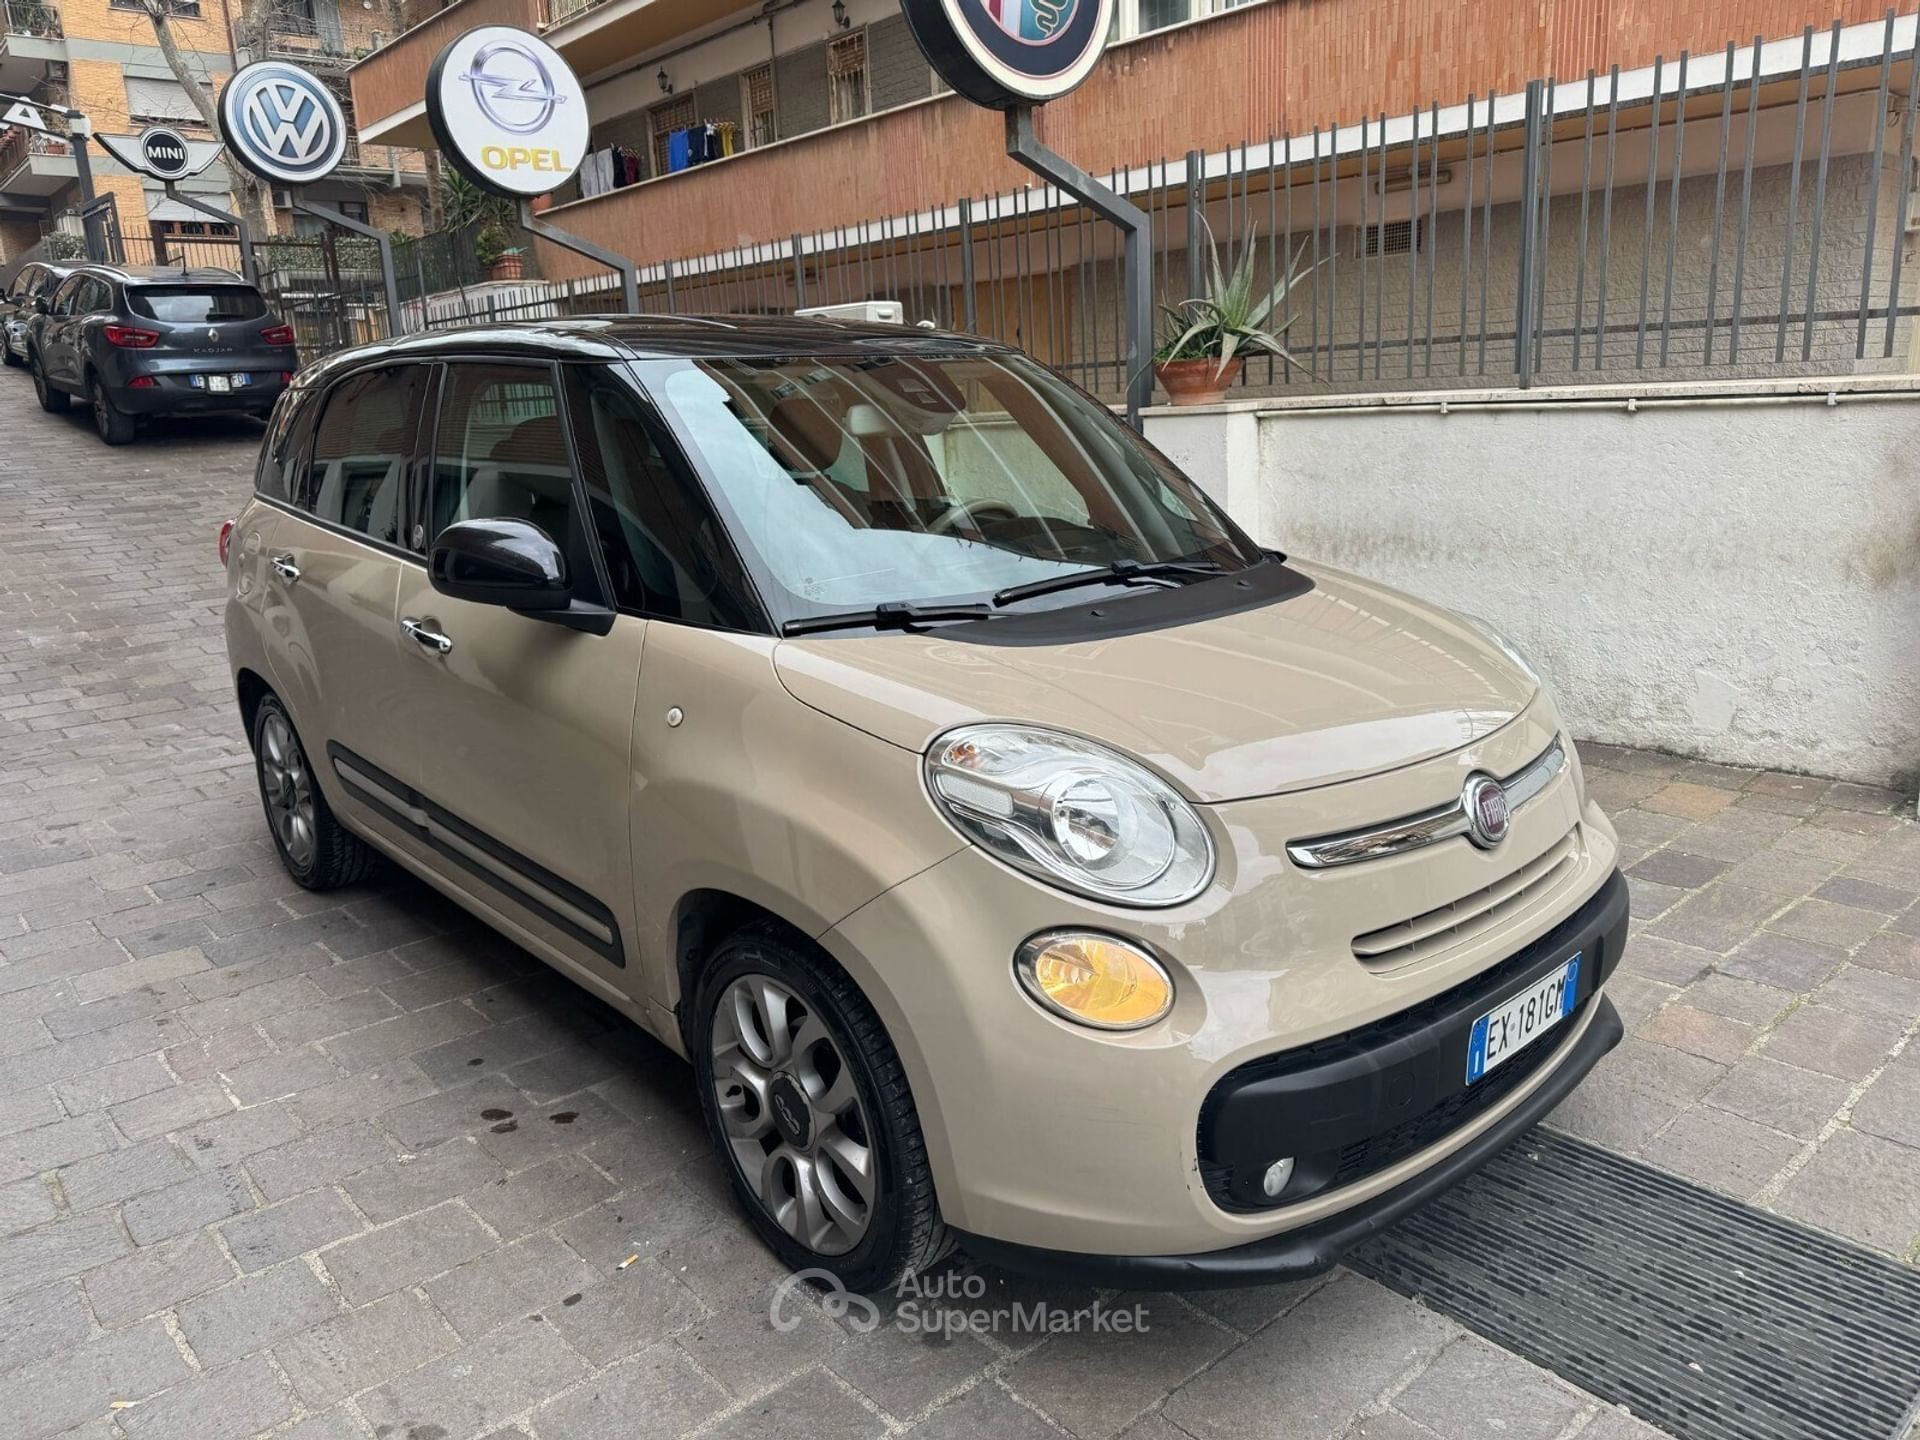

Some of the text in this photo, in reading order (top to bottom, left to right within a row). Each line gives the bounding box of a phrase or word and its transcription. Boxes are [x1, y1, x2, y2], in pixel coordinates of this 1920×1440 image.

[147, 145, 184, 160] MINI
[481, 145, 573, 172] OPEL
[1487, 1010, 1512, 1060] EX
